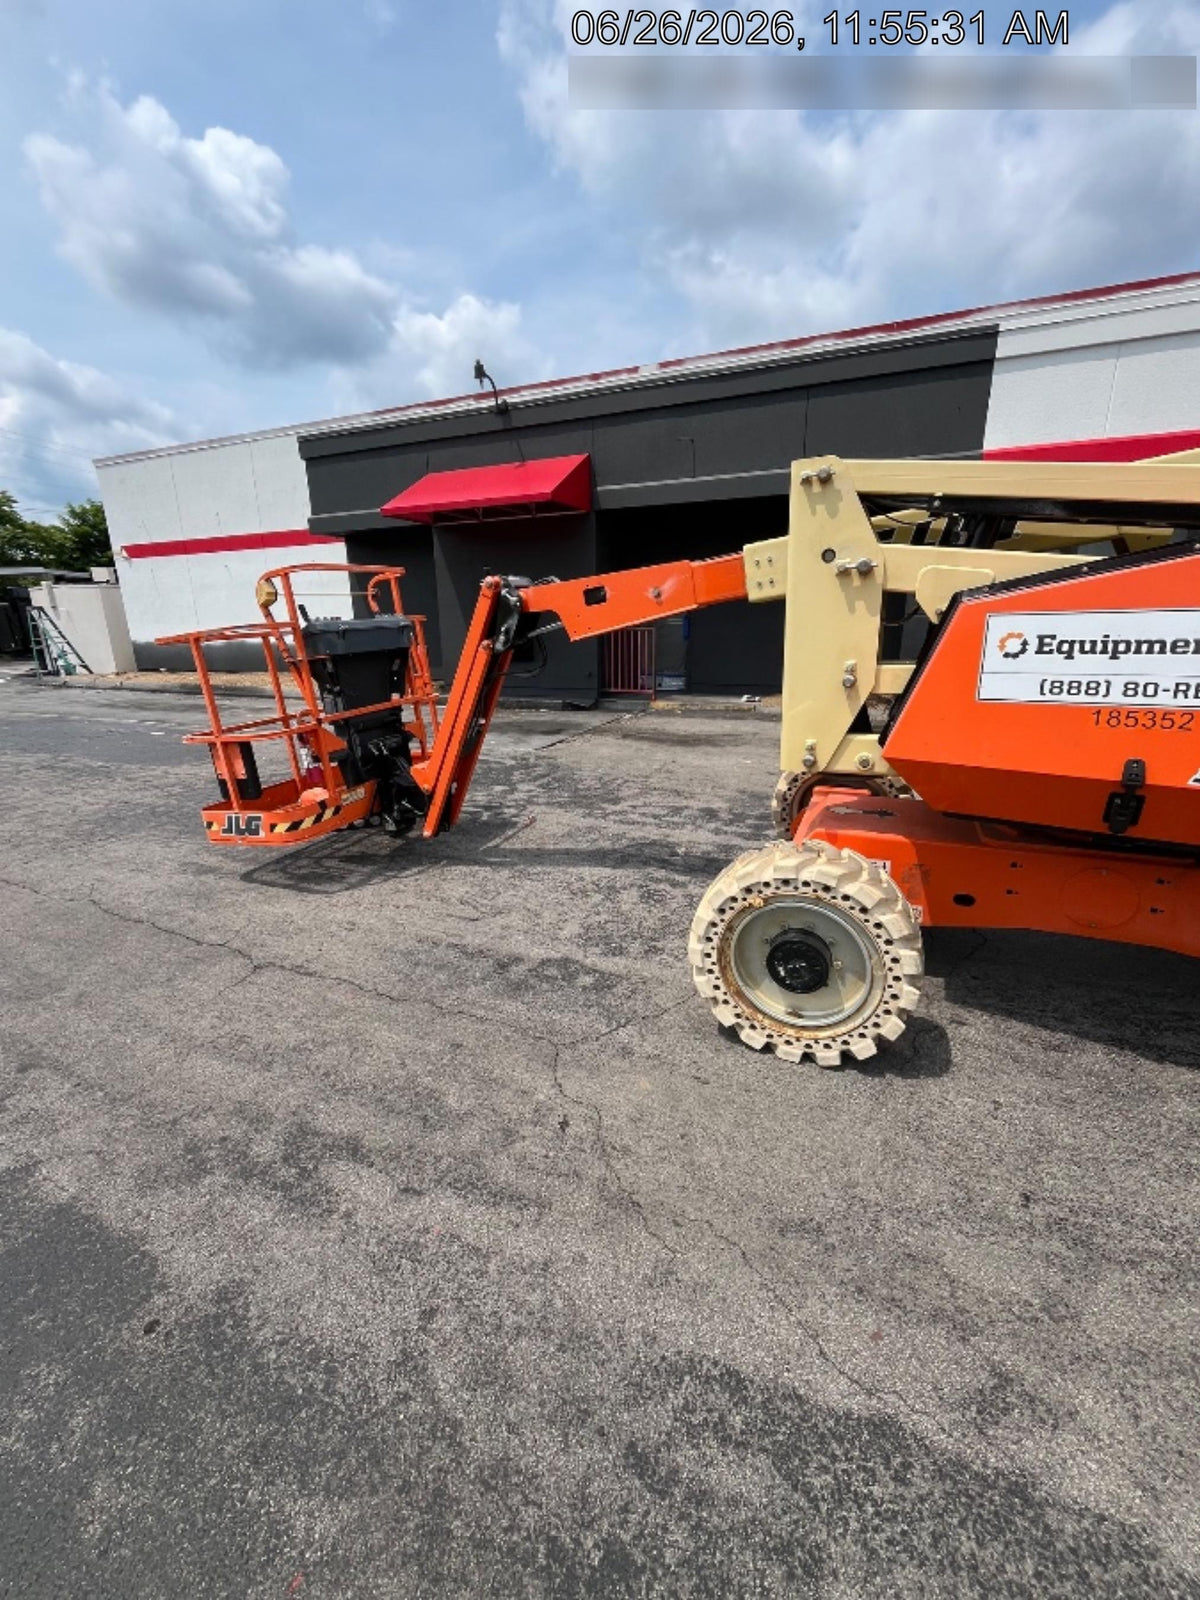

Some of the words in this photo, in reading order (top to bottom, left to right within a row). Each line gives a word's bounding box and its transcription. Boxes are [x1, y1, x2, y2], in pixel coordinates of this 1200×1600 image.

[1039, 678, 1112, 698] (888)
[1092, 708, 1195, 731] 185352
[221, 814, 263, 836] JLG
